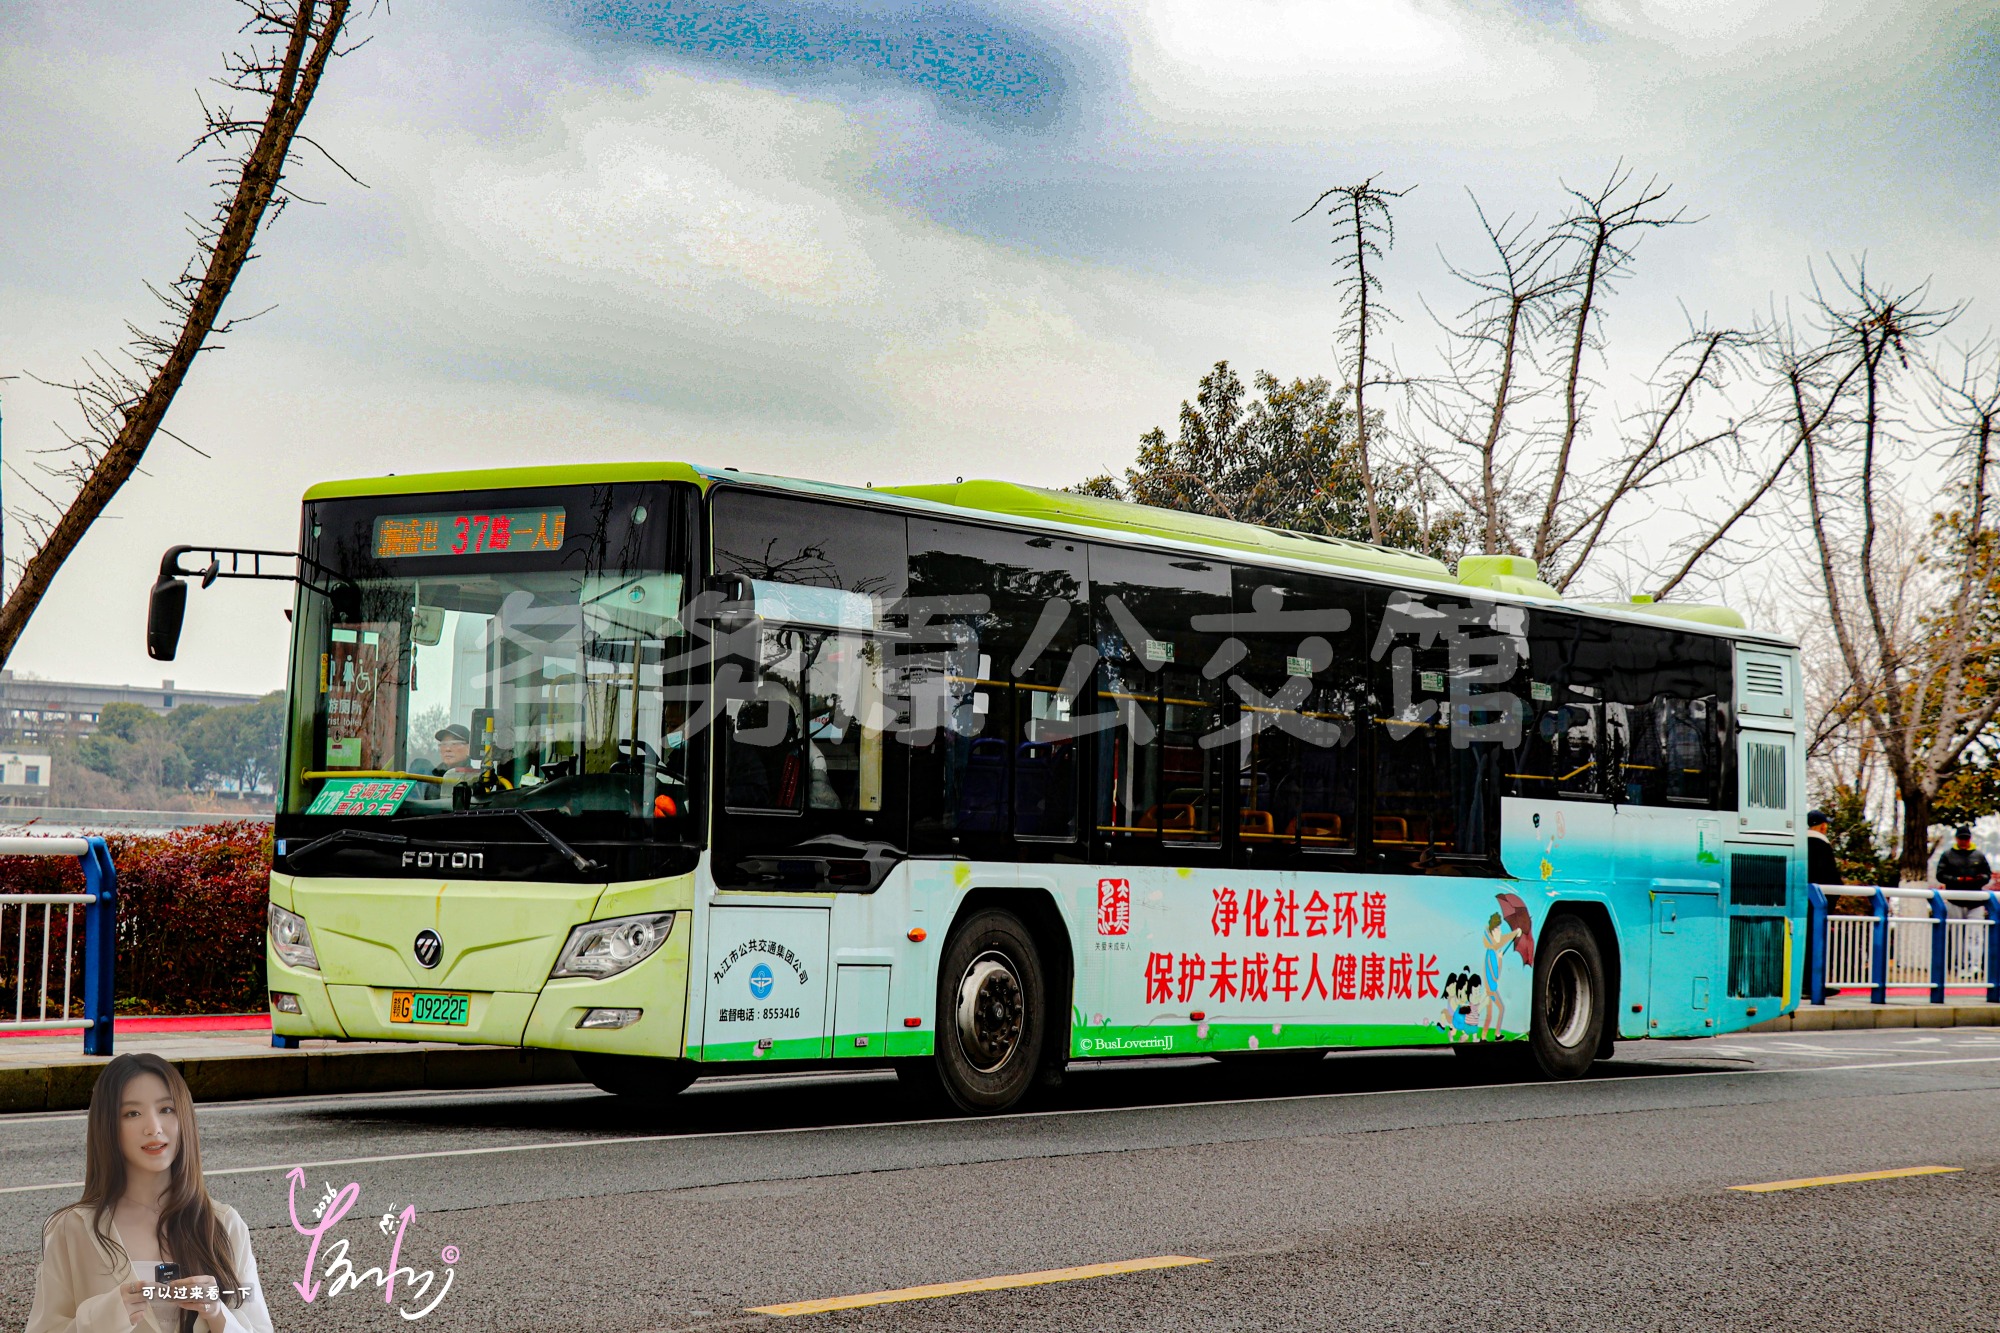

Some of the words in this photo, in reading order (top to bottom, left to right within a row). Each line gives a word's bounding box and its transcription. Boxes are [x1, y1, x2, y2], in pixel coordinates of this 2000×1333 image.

[451, 515, 511, 555] 37路
[345, 783, 409, 800] 空调开启
[332, 801, 394, 815] 票价2元
[402, 851, 483, 868] FOTON
[1211, 887, 1387, 939] 净化社会环境
[1095, 942, 1132, 951] 关爱未成年人
[713, 939, 809, 985] 九江市公共交通集团公司
[1144, 951, 1440, 1005] 保护未成年人健康成长
